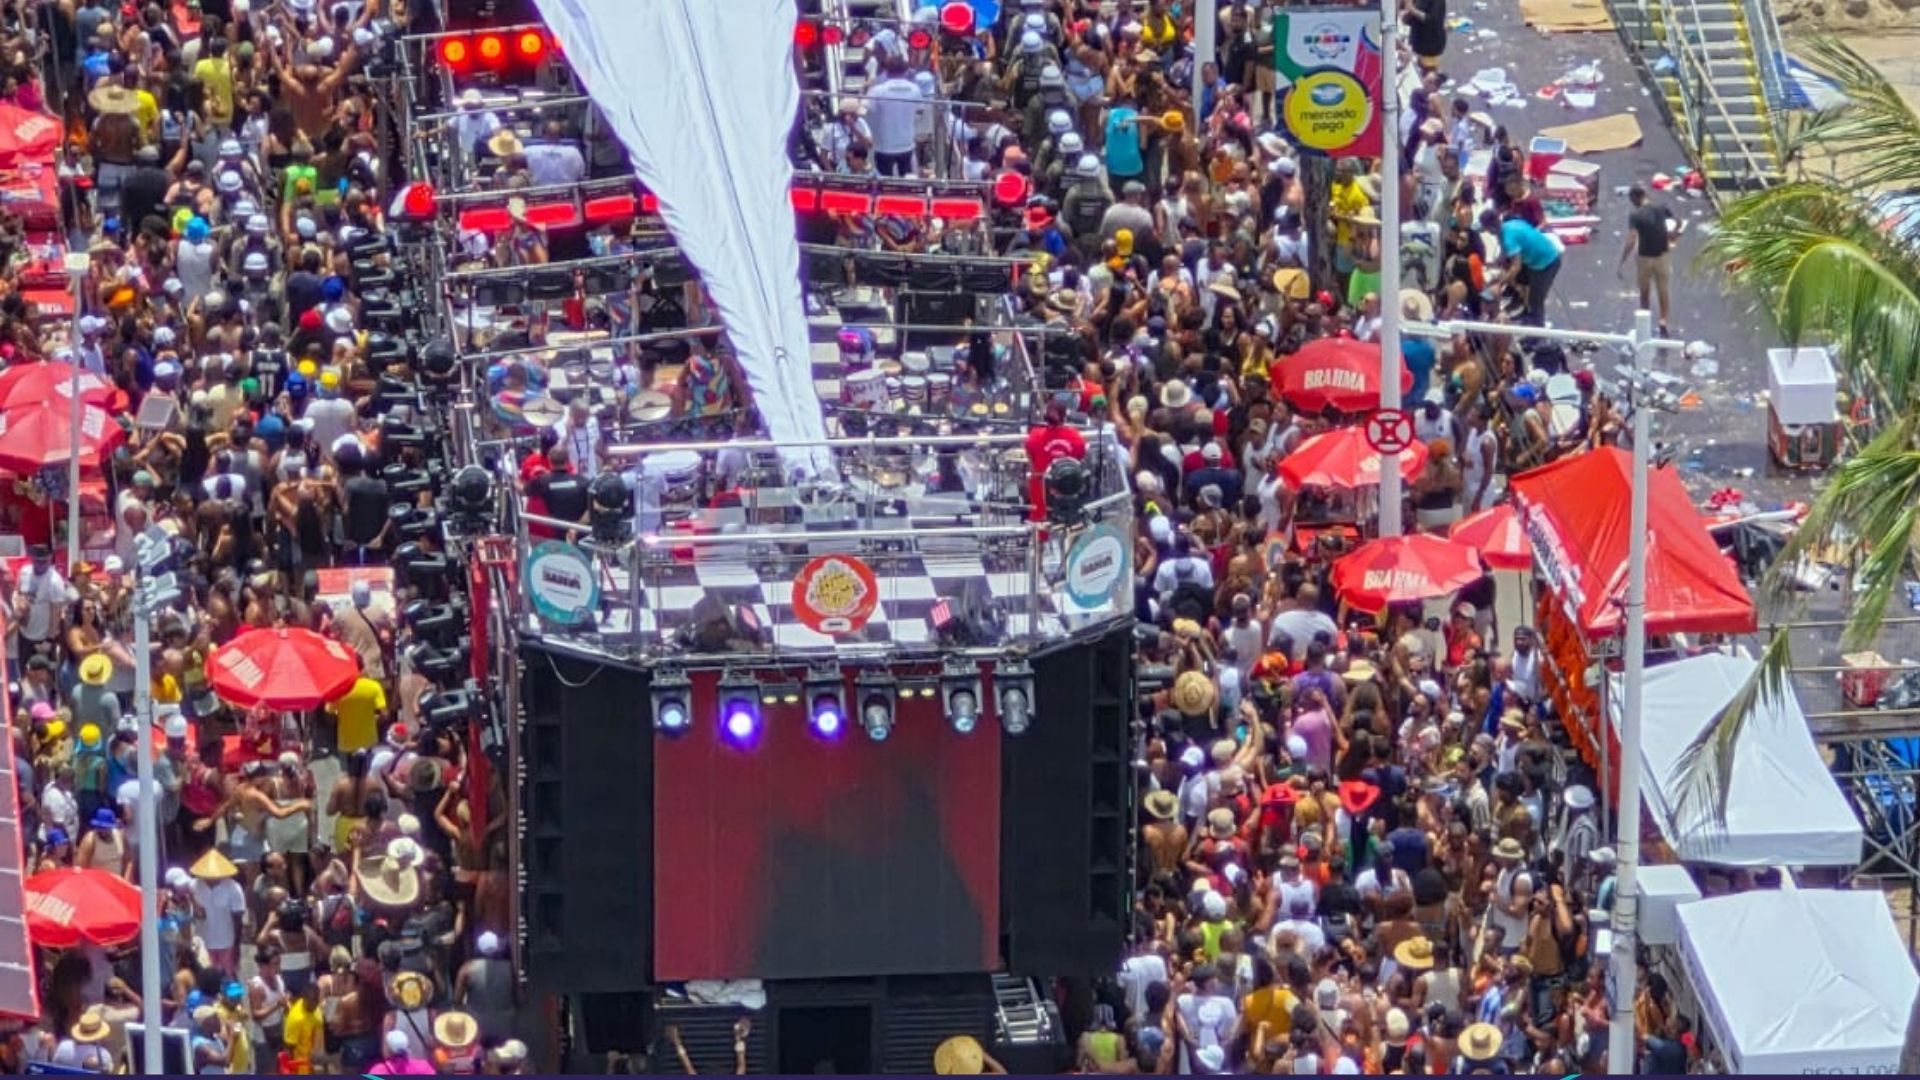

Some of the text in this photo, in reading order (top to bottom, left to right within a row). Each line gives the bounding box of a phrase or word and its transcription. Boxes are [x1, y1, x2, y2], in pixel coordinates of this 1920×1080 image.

[1300, 108, 1357, 121] mercado
[1312, 120, 1345, 133] pago
[1304, 367, 1366, 392] BRAHMA
[1363, 569, 1429, 591] BRAHMA
